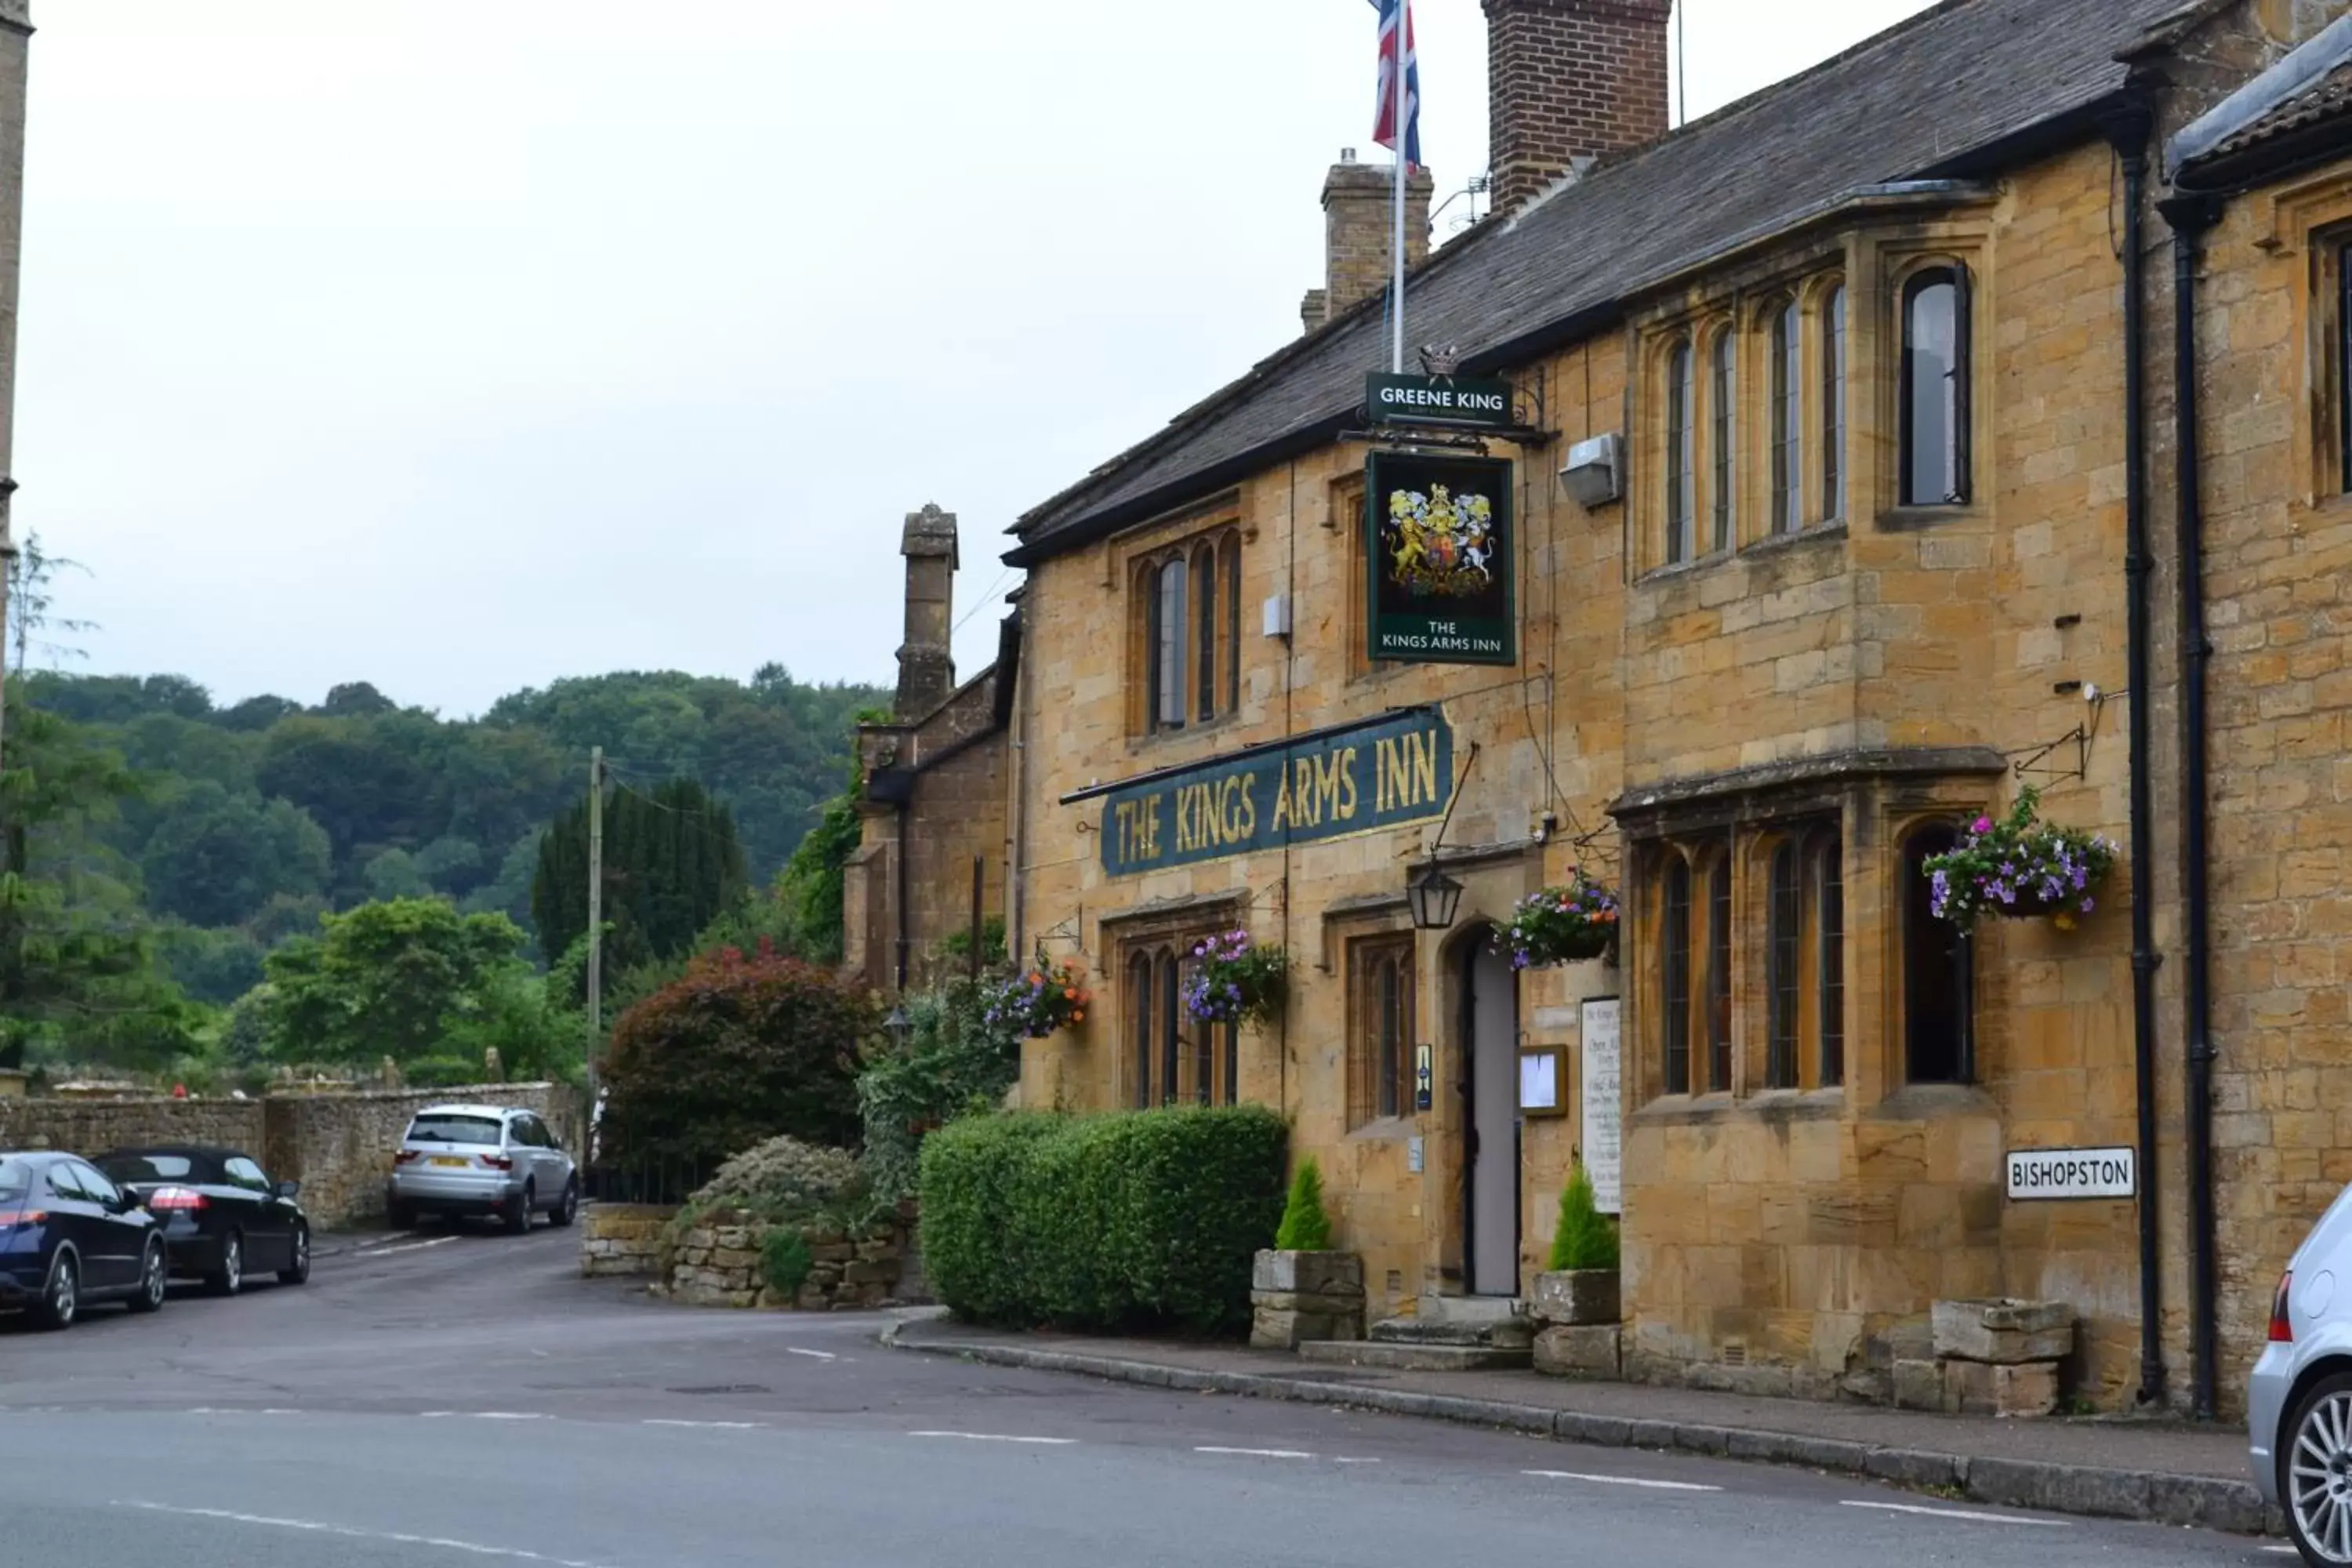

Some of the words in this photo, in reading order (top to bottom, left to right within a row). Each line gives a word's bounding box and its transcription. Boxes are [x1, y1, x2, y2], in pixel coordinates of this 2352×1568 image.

[1380, 387, 1452, 407] GREENE
[1457, 392, 1503, 411] KING
[1428, 620, 1457, 635] THE
[1382, 633, 1428, 649] KINGS
[1431, 636, 1470, 651] ARMS
[1473, 639, 1501, 652] INN
[1115, 793, 1161, 864] THE
[1176, 771, 1256, 853] KINGS
[1272, 746, 1358, 833] ARMS
[1374, 728, 1436, 814] INN
[2012, 1159, 2129, 1188] BISHOPSTON
